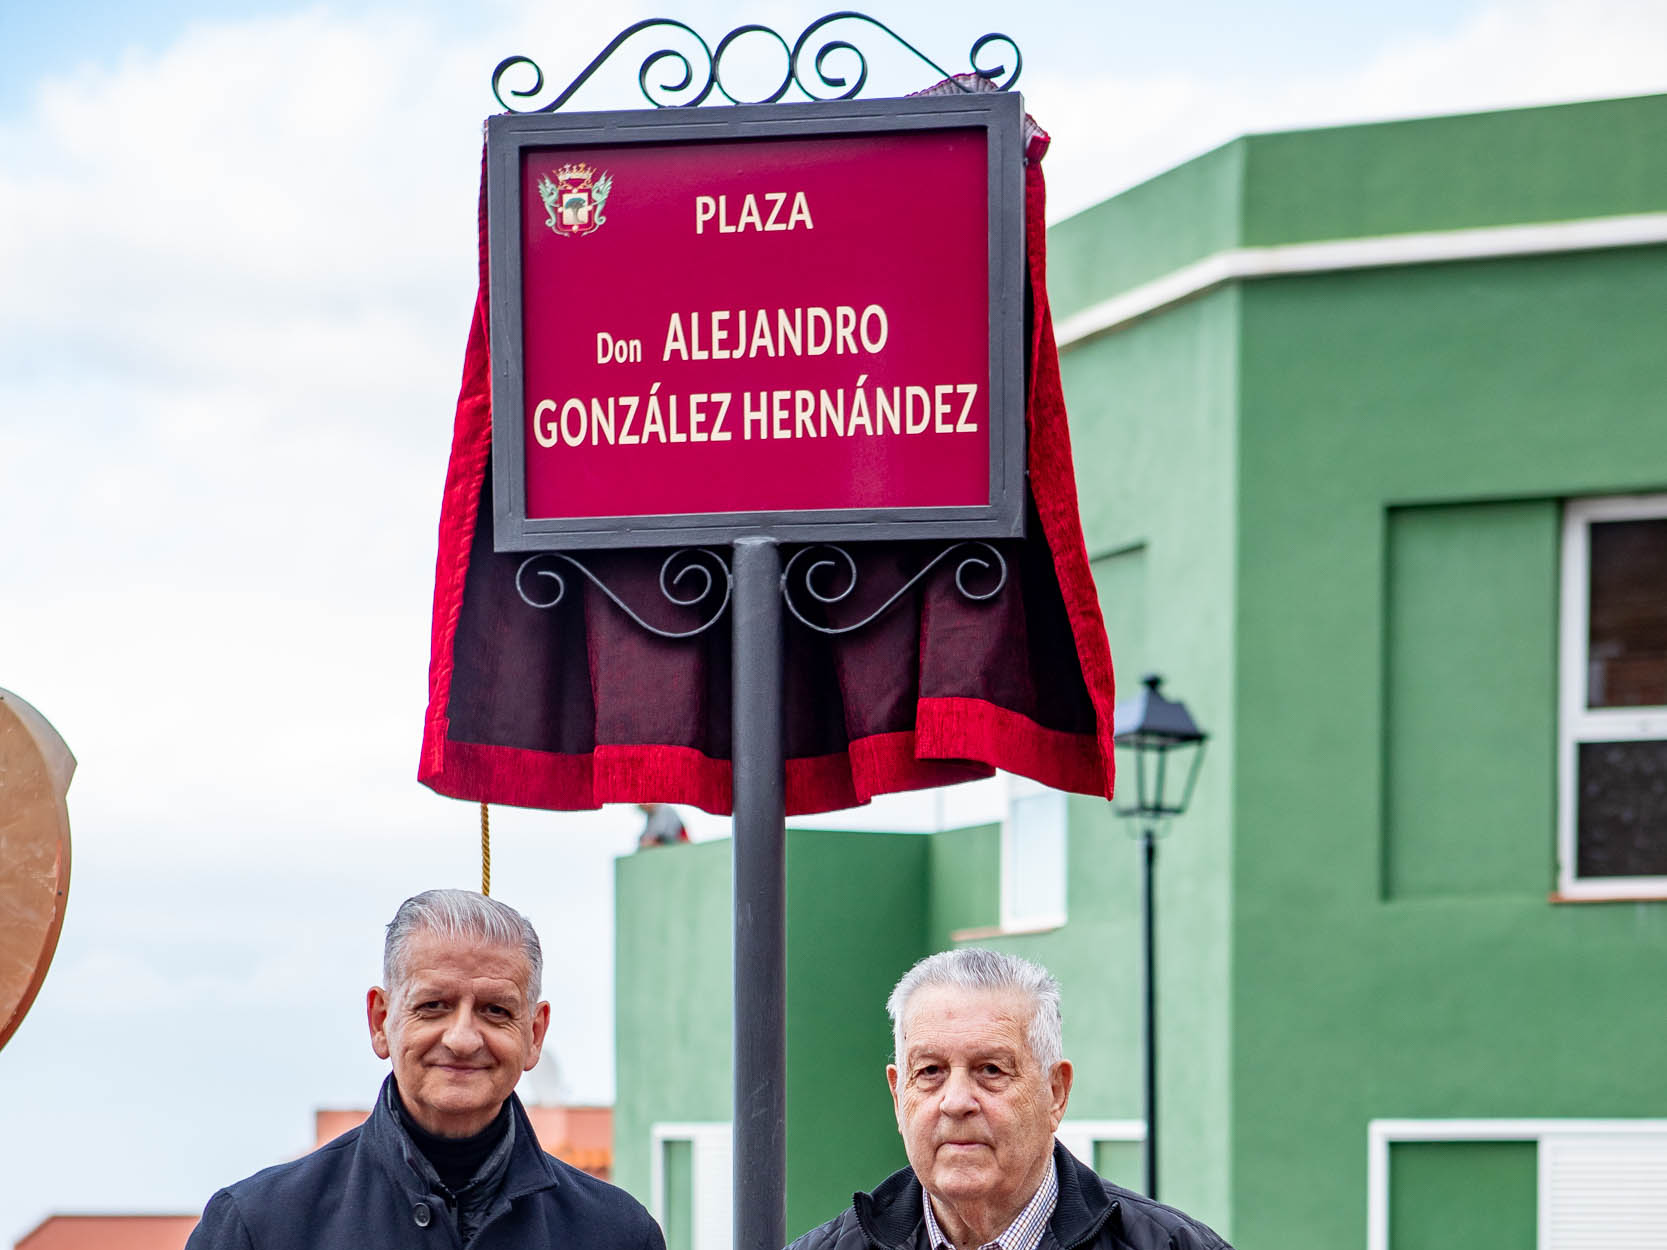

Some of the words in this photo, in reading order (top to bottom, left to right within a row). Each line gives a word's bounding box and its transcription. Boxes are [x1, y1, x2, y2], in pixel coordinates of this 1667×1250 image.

[695, 191, 814, 234] PLAZA
[596, 331, 642, 364] Don
[662, 303, 889, 363] ALEJANDRO
[533, 381, 732, 448] GONZÁLEZ
[743, 374, 978, 441] HERNÁNDEZ
